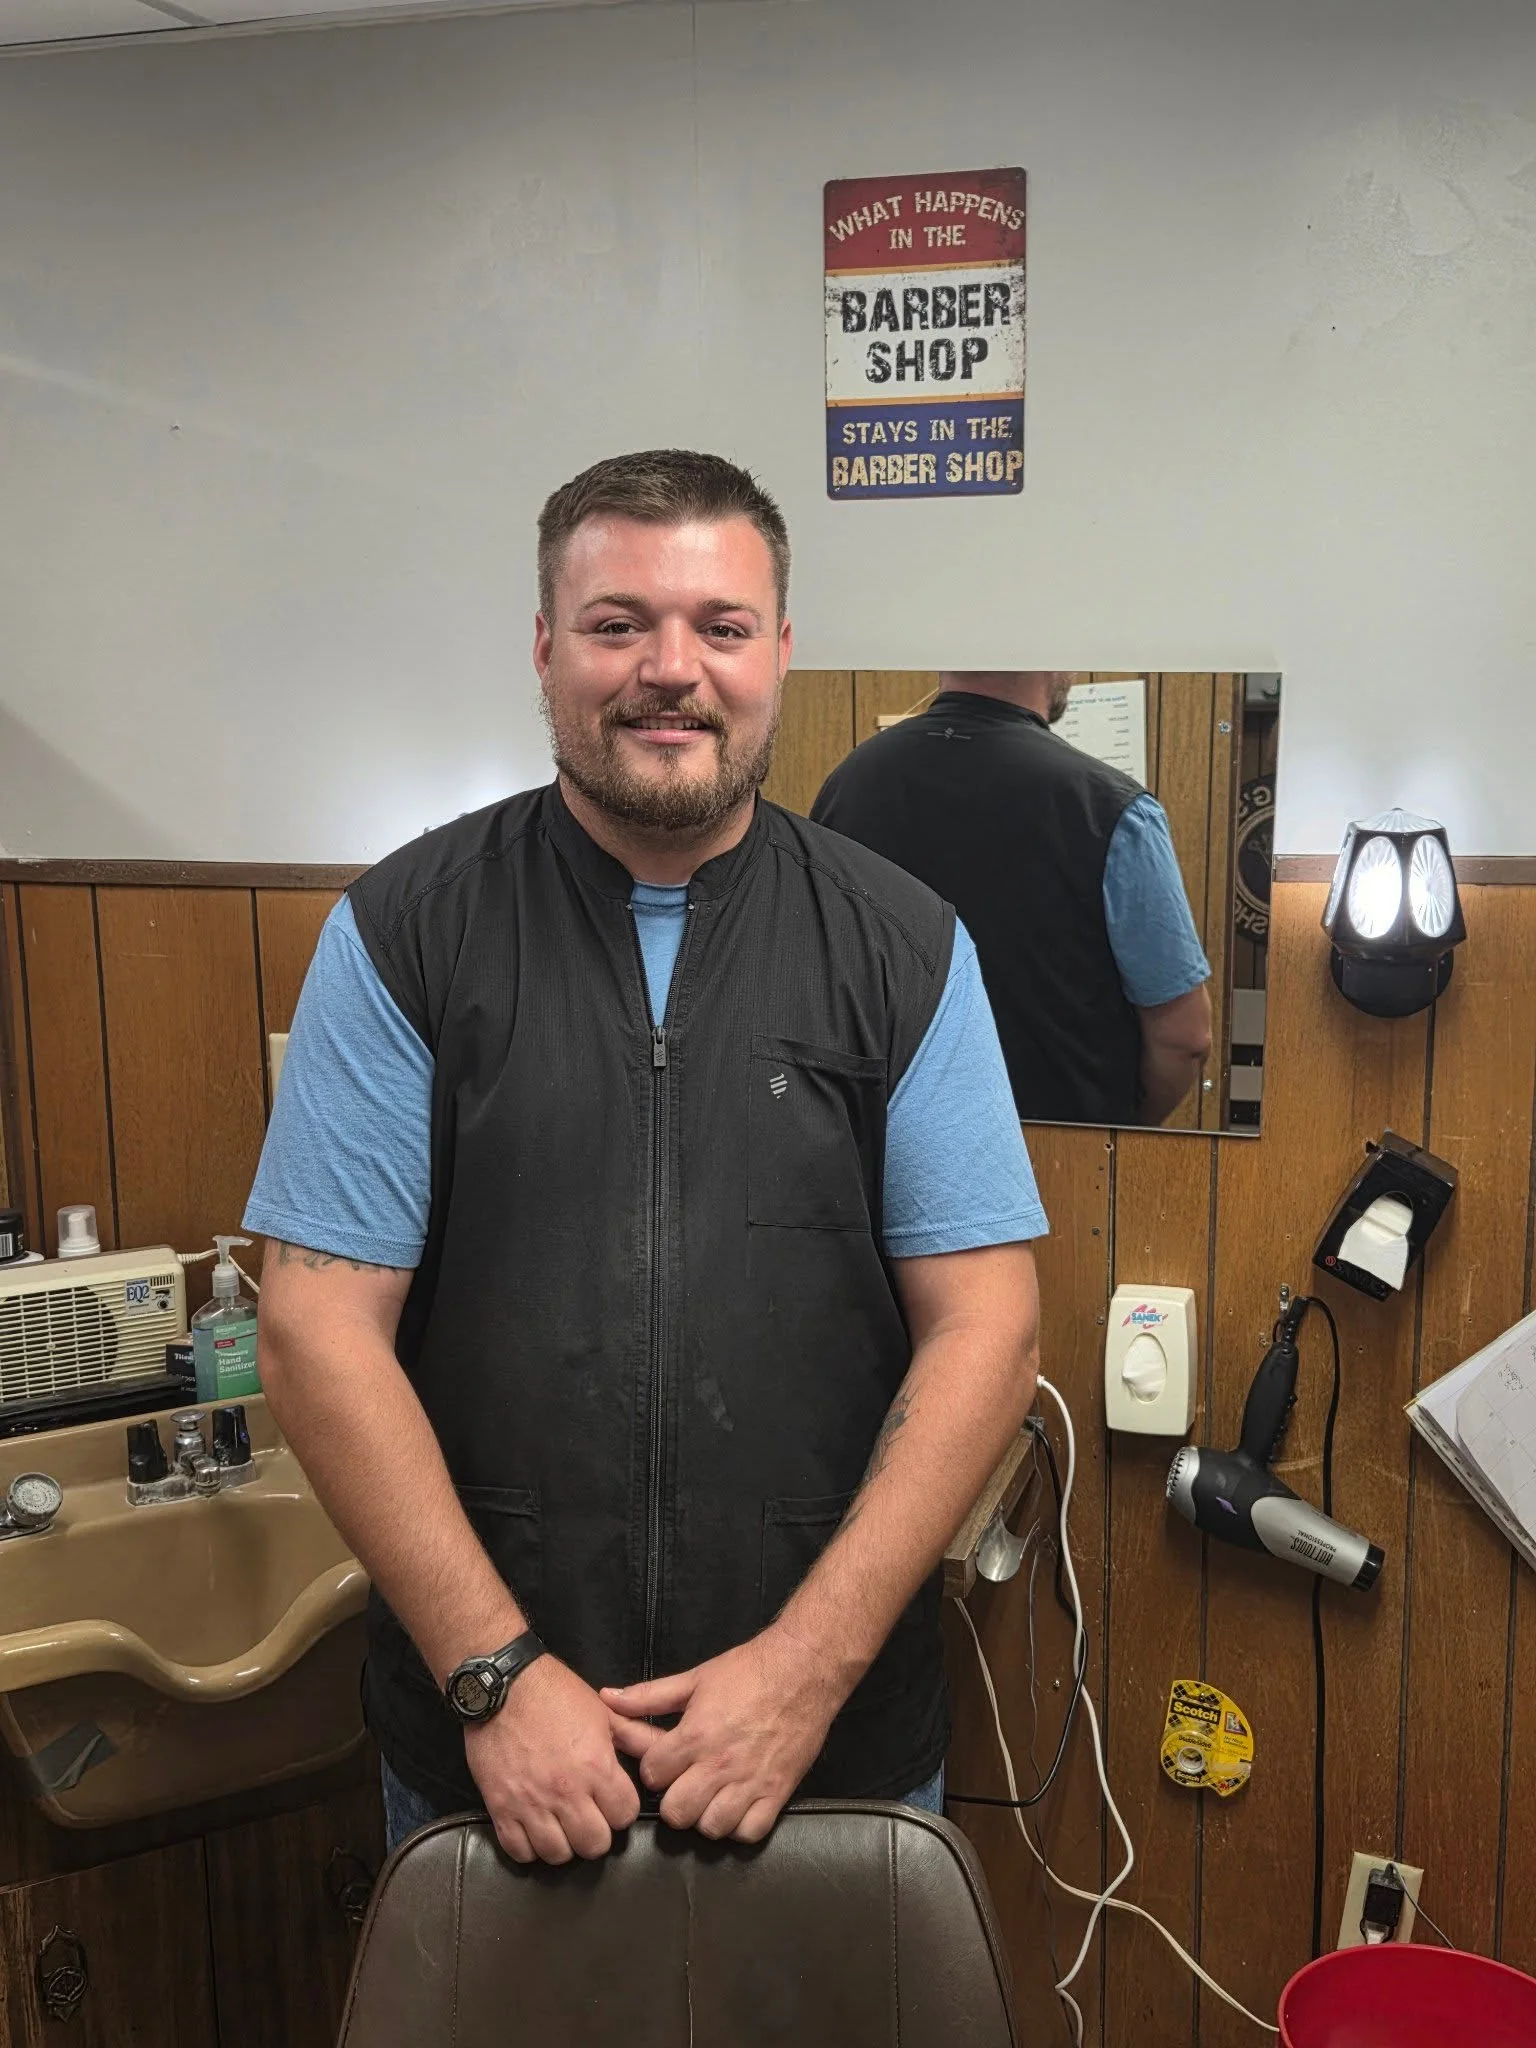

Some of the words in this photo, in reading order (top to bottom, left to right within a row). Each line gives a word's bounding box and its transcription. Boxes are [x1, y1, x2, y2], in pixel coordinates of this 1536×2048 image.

[829, 195, 902, 242] WHAT
[915, 190, 1025, 231] HAPPENS
[889, 228, 913, 249] IN
[923, 224, 966, 248] THE
[841, 282, 1011, 333] BARBER
[865, 337, 989, 383] SHOP
[842, 420, 918, 444] STAYS
[929, 419, 955, 441] IN
[966, 416, 1012, 440] THE
[832, 453, 937, 486] BARBER
[945, 450, 1024, 483] SHOP
[219, 1356, 242, 1366] Hand
[219, 1361, 256, 1373] Sanitizer
[1290, 1537, 1317, 1558] TOOLS
[1313, 1549, 1334, 1566] HOT
[1173, 1701, 1218, 1722] Scotch
